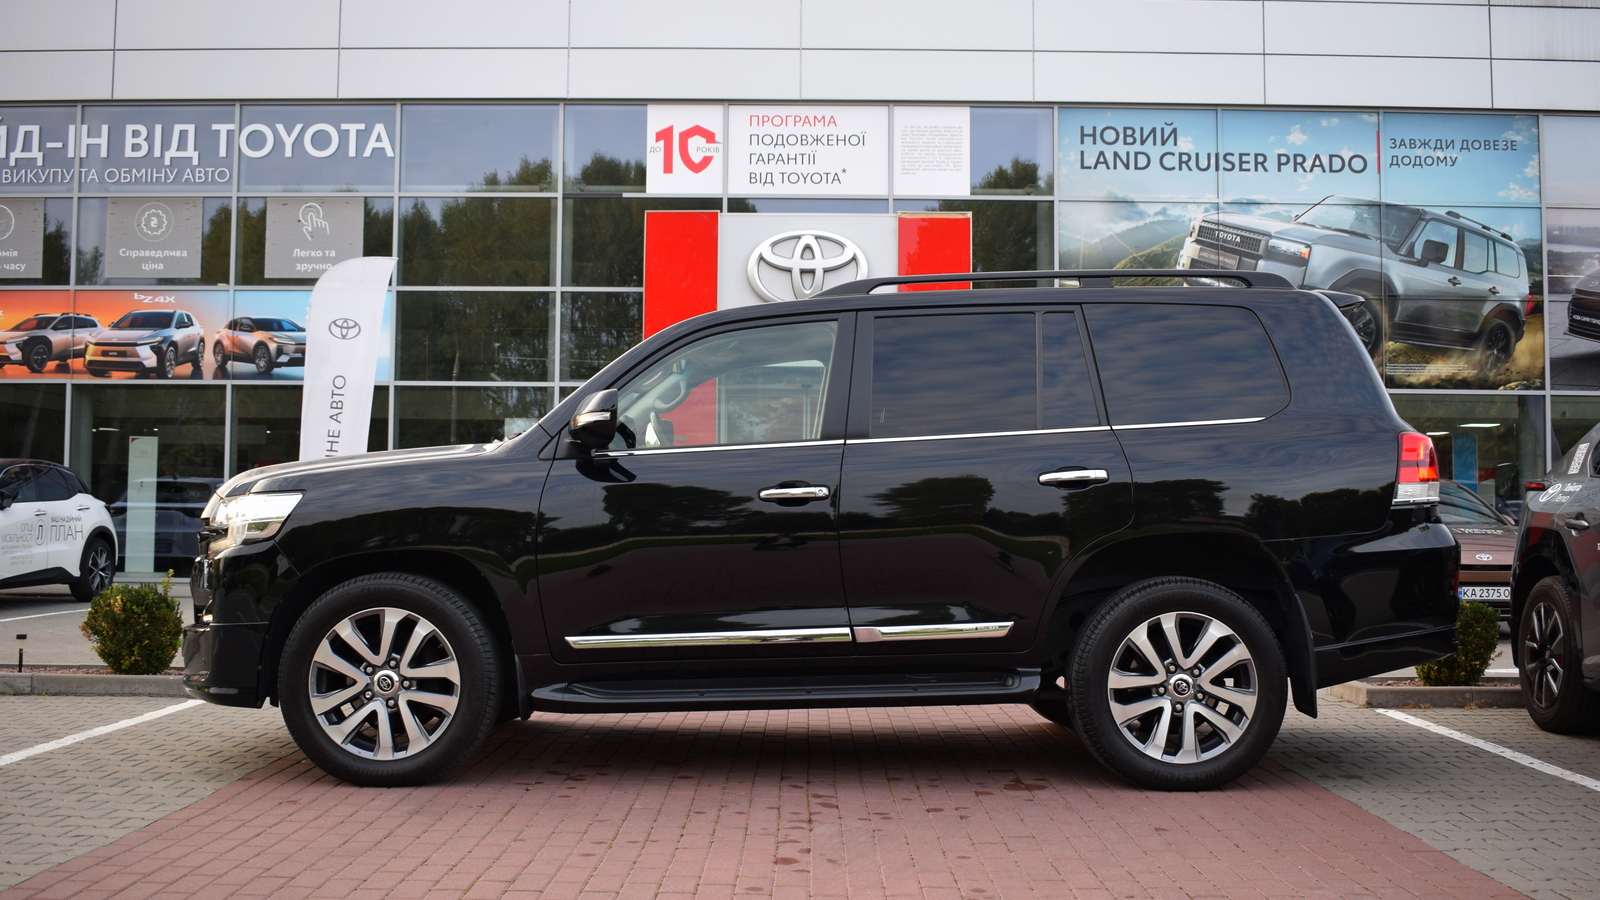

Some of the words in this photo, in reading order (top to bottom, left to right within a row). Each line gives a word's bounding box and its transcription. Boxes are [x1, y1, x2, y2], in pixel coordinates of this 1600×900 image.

[749, 115, 838, 127] ПРОГРАМА
[749, 131, 867, 148] ПОДОВЖЕНОЇ
[1080, 121, 1178, 147] НОВИЙ
[0, 116, 109, 166] Д-ІН
[124, 123, 199, 166] ВІД
[211, 122, 395, 158] TOYOTA
[1389, 138, 1455, 152] ЗАВЖДИ
[1459, 139, 1518, 152] ДОВЕЗЕ
[649, 146, 661, 154] ДО
[749, 150, 817, 165] ГАРАНТІЇ
[1080, 150, 1151, 170] LAND
[1159, 151, 1268, 172] CRUISER
[1277, 153, 1368, 174] PRADO
[1389, 155, 1458, 168] ДОДОМУ
[2, 168, 75, 183] ВИКУПУ
[79, 168, 99, 183] ТА
[104, 168, 178, 183] ОБМІНУ
[182, 167, 230, 183] АВТО
[749, 172, 774, 186] ВІД
[1215, 231, 1240, 242] TOYOTA
[0, 248, 18, 257] мія
[119, 248, 188, 259] Справедлива
[292, 248, 322, 257] Легко
[3, 263, 26, 272] часу
[142, 261, 164, 271] ціна
[295, 262, 333, 272] зручно
[329, 375, 346, 424] АВТО
[50, 525, 84, 541] ПЛАН
[1479, 588, 1501, 598] 2375
